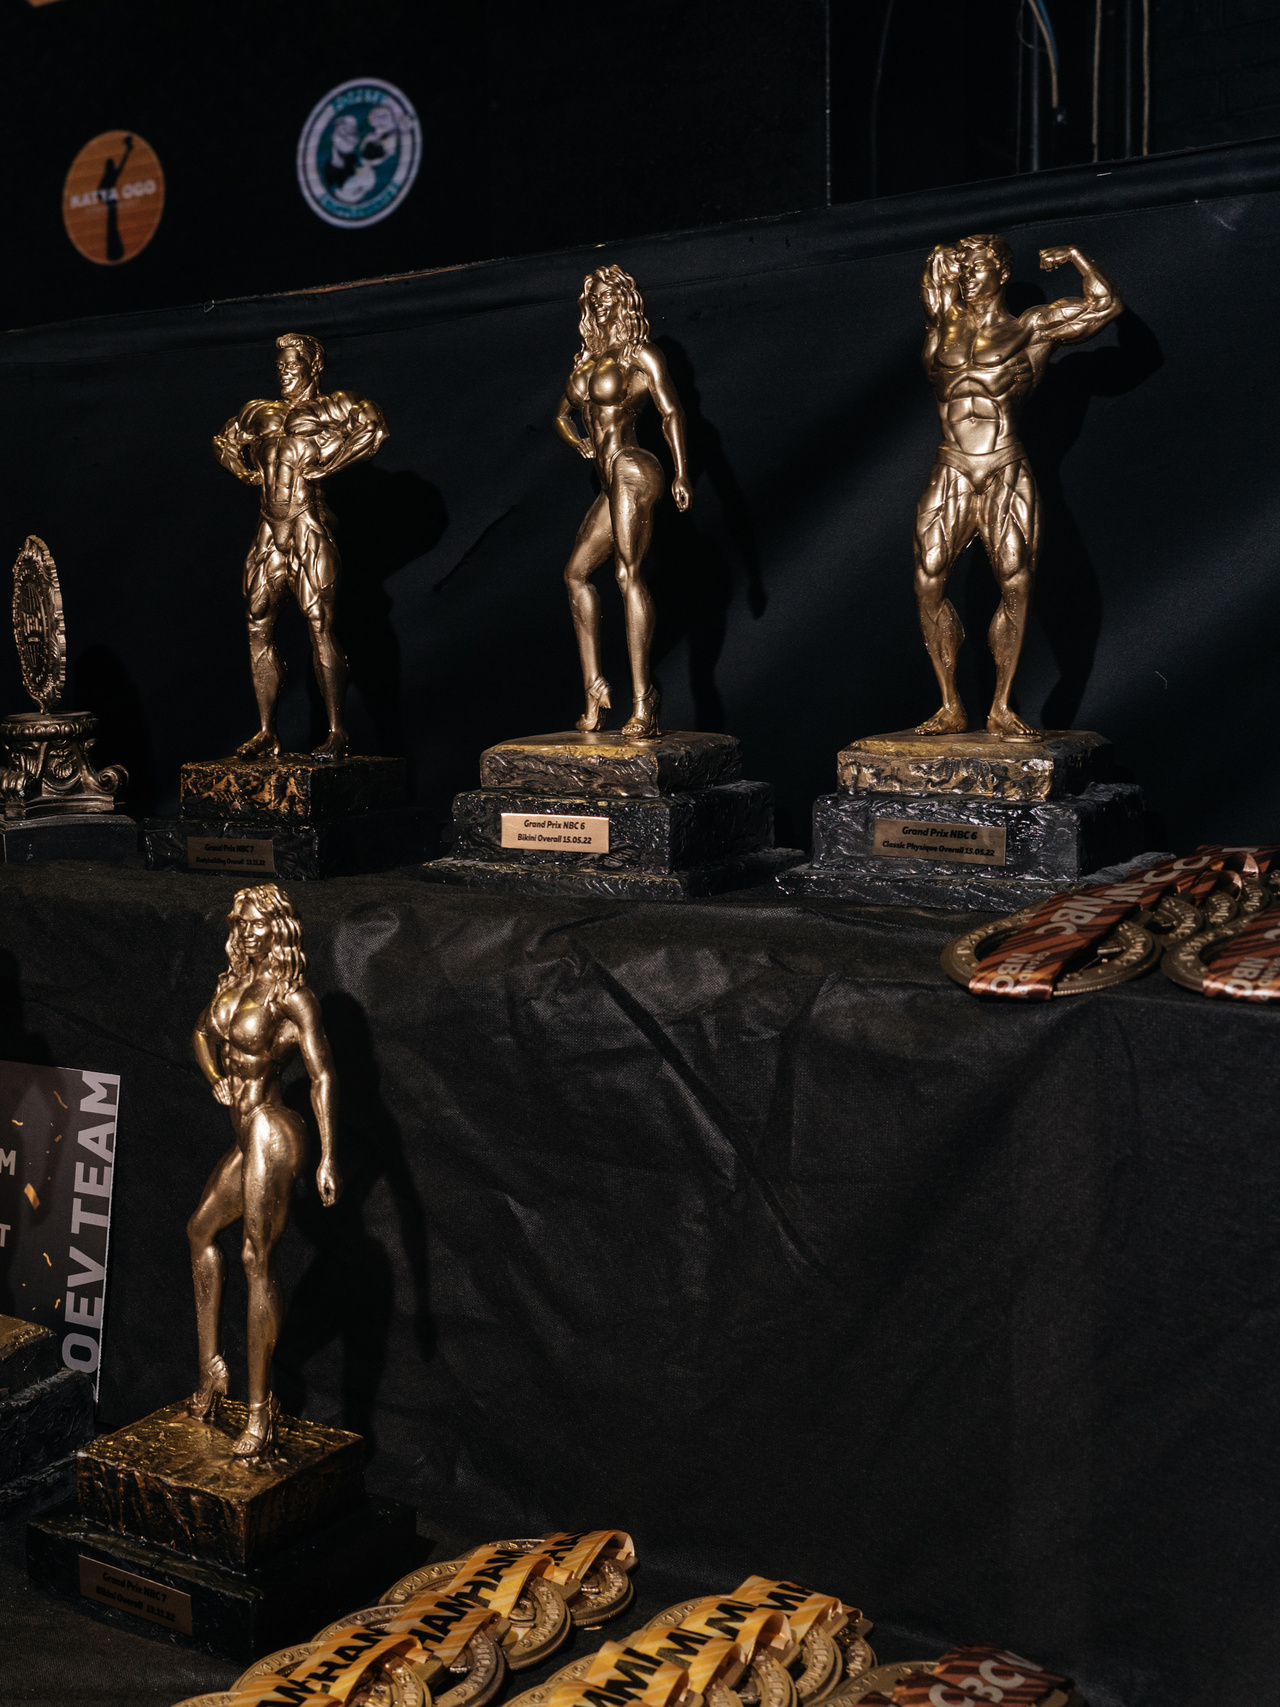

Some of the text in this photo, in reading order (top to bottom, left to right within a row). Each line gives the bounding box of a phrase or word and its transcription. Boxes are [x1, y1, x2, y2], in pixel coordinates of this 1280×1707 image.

[524, 820, 586, 830] Grand Prix NBC 6
[902, 826, 978, 840] Grand Prix NBC 6
[223, 844, 236, 852] Prix
[517, 834, 592, 844] Bikini Overall 15.05.22
[882, 840, 995, 857] Classic Physique Overall 15.05.22
[1034, 894, 1114, 936] NBC
[989, 952, 1034, 993] NBC
[1224, 956, 1271, 997] NBC
[71, 1070, 120, 1236] TEAM
[96, 1585, 116, 1601] Bikini
[117, 1594, 144, 1610] Overall
[102, 1572, 168, 1603] Grand Prix NBC 7
